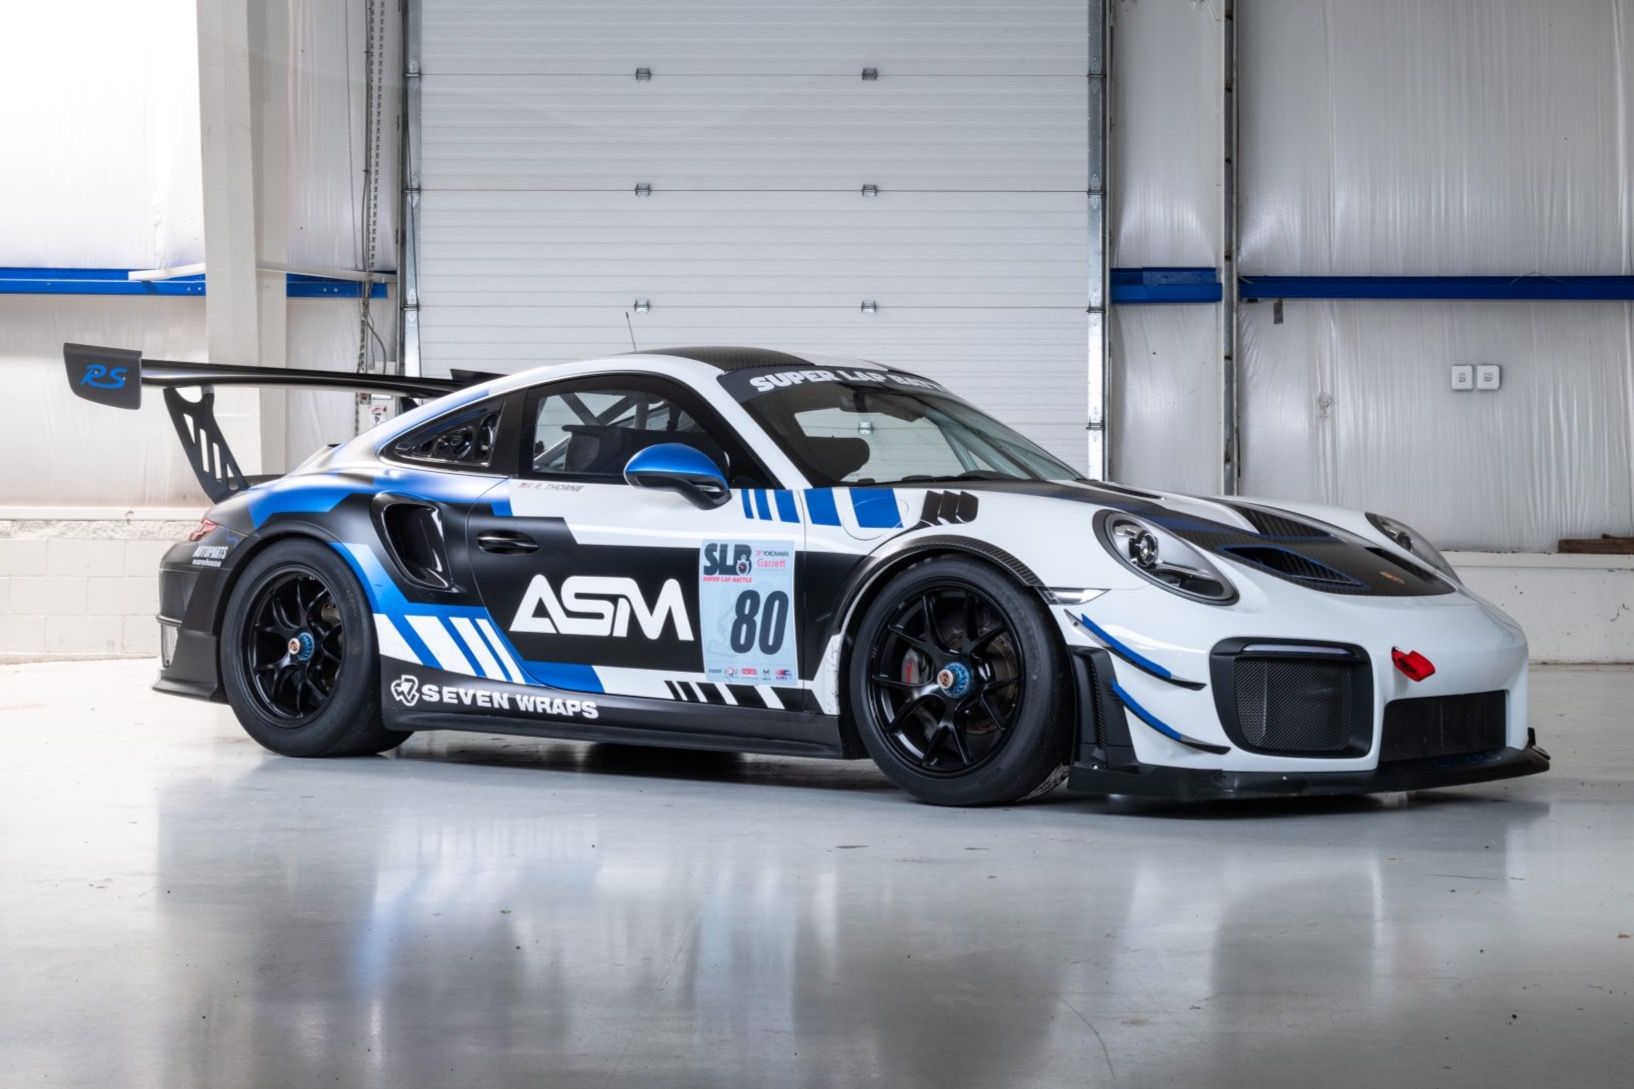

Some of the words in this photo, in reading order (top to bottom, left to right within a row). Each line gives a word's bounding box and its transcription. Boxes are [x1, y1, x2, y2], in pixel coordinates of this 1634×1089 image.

[80, 364, 128, 389] RS
[749, 370, 841, 392] SUPER
[836, 370, 887, 383] LAP
[703, 543, 752, 576] SLB
[757, 558, 786, 568] Garrett
[509, 574, 695, 641] ASM
[730, 589, 789, 655] 80
[420, 684, 510, 709] SEVEN
[515, 693, 599, 719] WRAPS
